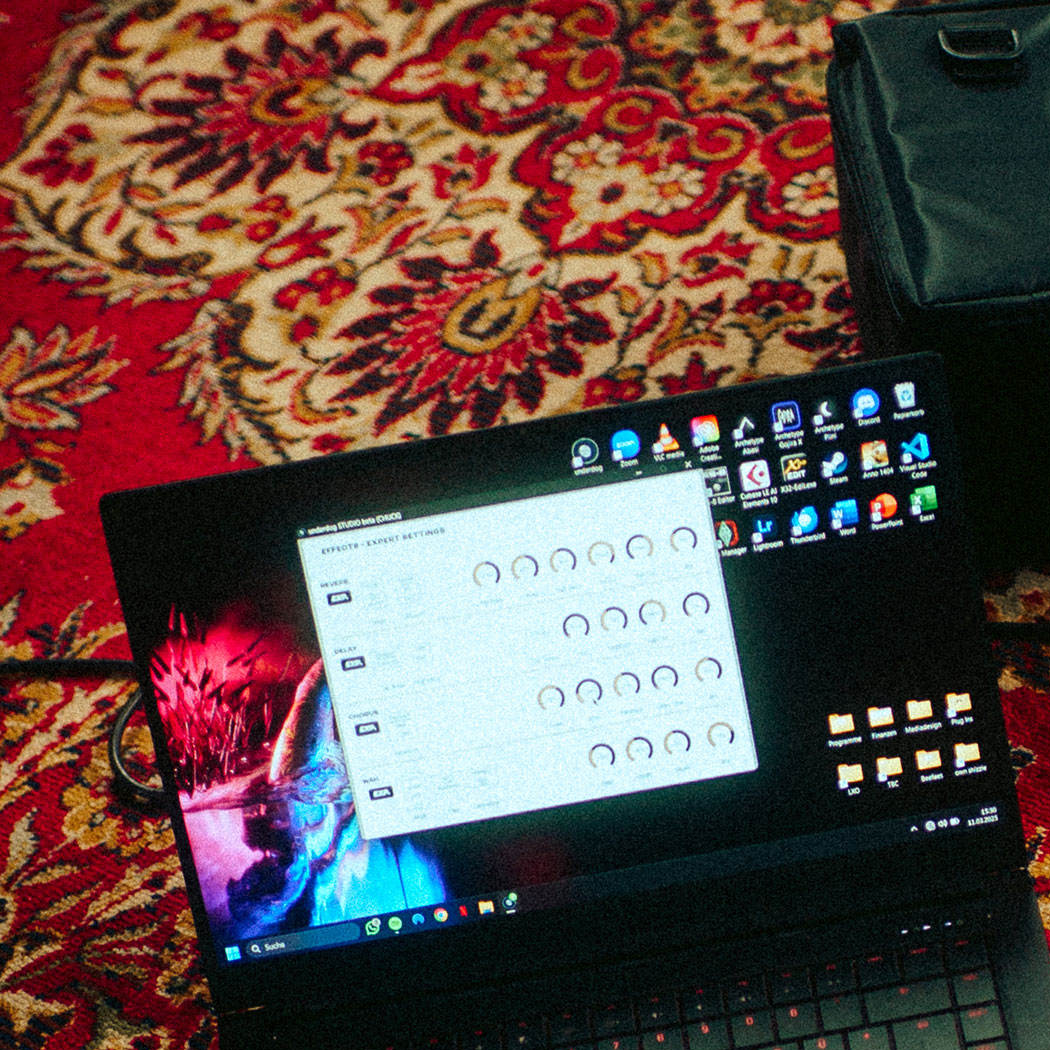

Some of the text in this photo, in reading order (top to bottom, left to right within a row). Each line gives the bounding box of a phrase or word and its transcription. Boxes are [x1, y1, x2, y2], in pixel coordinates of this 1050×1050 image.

[858, 416, 881, 426] Discord
[814, 423, 845, 434] Archetype
[774, 430, 804, 441] Archetype
[734, 437, 764, 448] Archetype
[699, 445, 720, 454] Adobe
[653, 453, 665, 461] VLC
[620, 459, 639, 468] Zoom
[899, 460, 937, 472] Visual Studio
[863, 470, 879, 479] Anno
[911, 470, 928, 480] Code
[829, 476, 849, 485] Steam
[919, 513, 935, 523] Excel
[338, 519, 361, 530] STUDIO
[871, 519, 904, 530] PowerPoint
[840, 527, 856, 536] Word
[321, 542, 359, 555] EFFECTS
[367, 535, 400, 547] EXPERT
[402, 527, 446, 540] SETTINGS
[790, 532, 826, 544] Thunderbird
[753, 540, 784, 552] Lightroom
[828, 736, 862, 747] Programme
[264, 941, 286, 952] Suche
